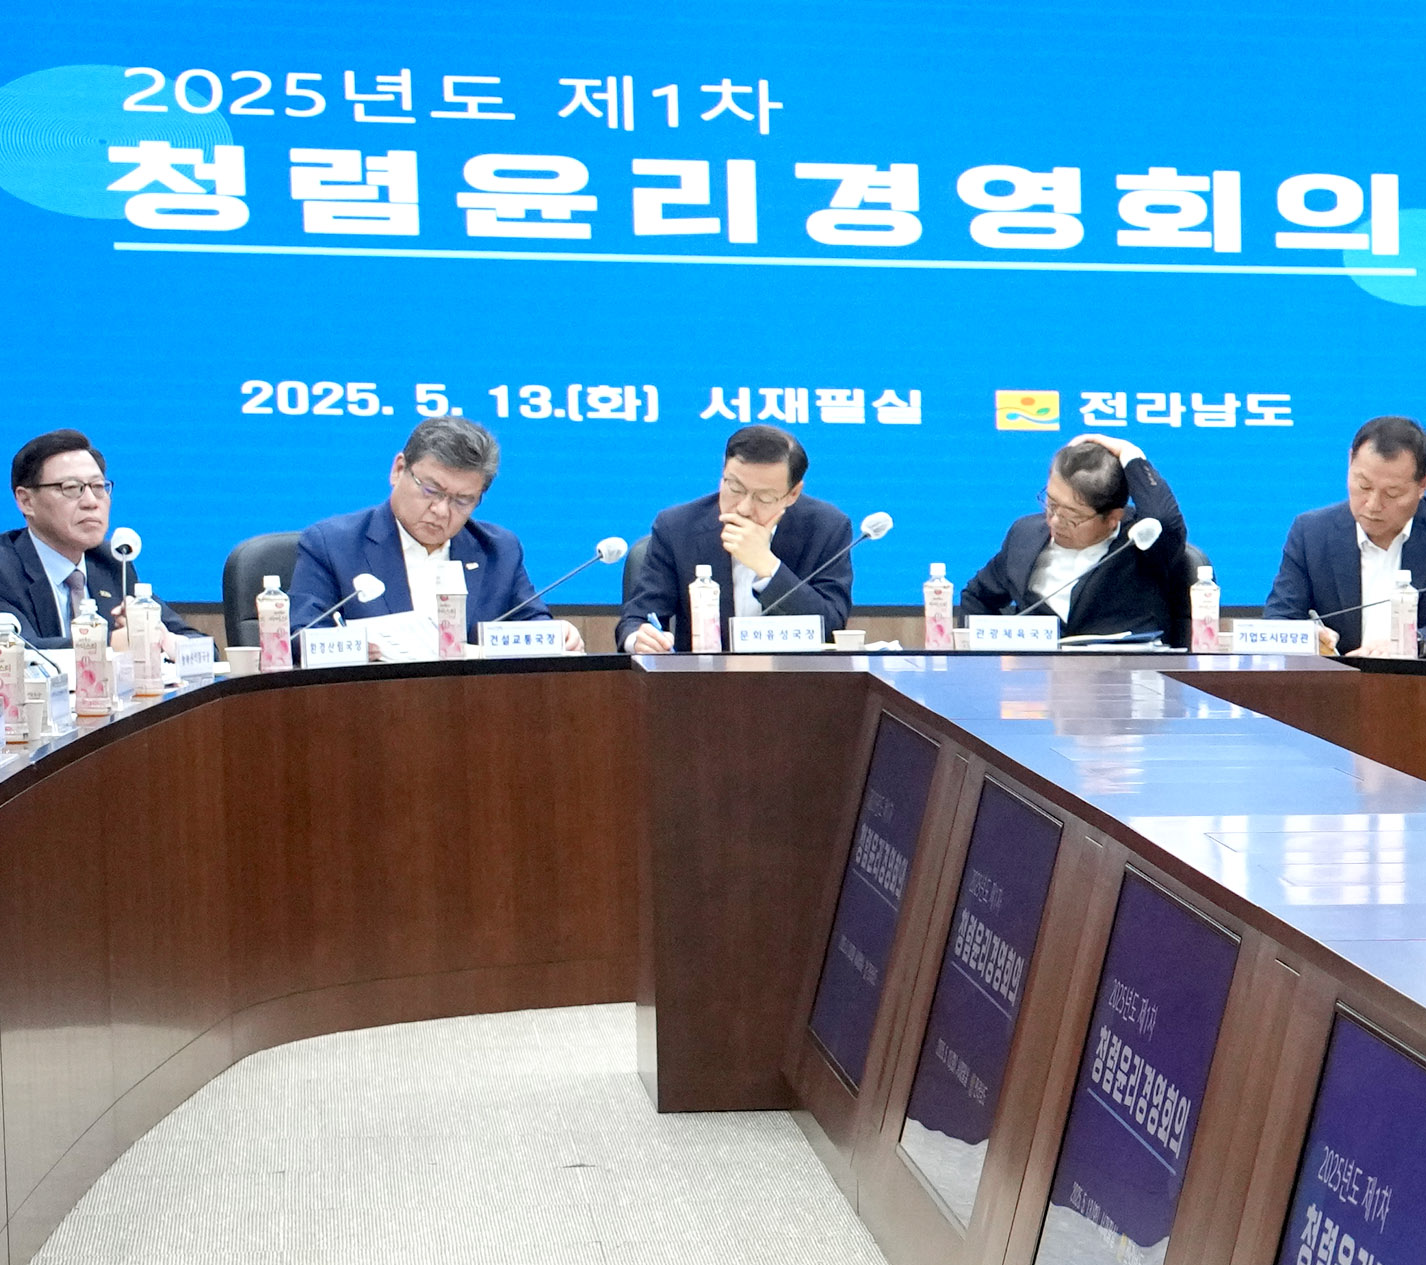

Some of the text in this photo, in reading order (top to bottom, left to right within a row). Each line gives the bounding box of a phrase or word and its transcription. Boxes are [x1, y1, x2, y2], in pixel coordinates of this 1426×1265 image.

[123, 66, 784, 136] 2025년도 제1차
[106, 140, 1400, 256] 청렴윤리경영회의
[240, 380, 395, 417] 2025.
[415, 383, 463, 418] 5.
[700, 384, 923, 426] 서재필실
[1079, 390, 1295, 429] 전라남도
[310, 640, 362, 654] 환경산림국장
[490, 633, 555, 646] 건설교통국장
[976, 628, 1053, 640] 관광체육국장
[1239, 632, 1309, 644] 기업도시담당관
[954, 907, 1025, 1007] 청렴윤리경영회의
[1092, 1024, 1191, 1159] 청렴윤리경영회의
[1317, 1145, 1393, 1235] 2025년도 제1차
